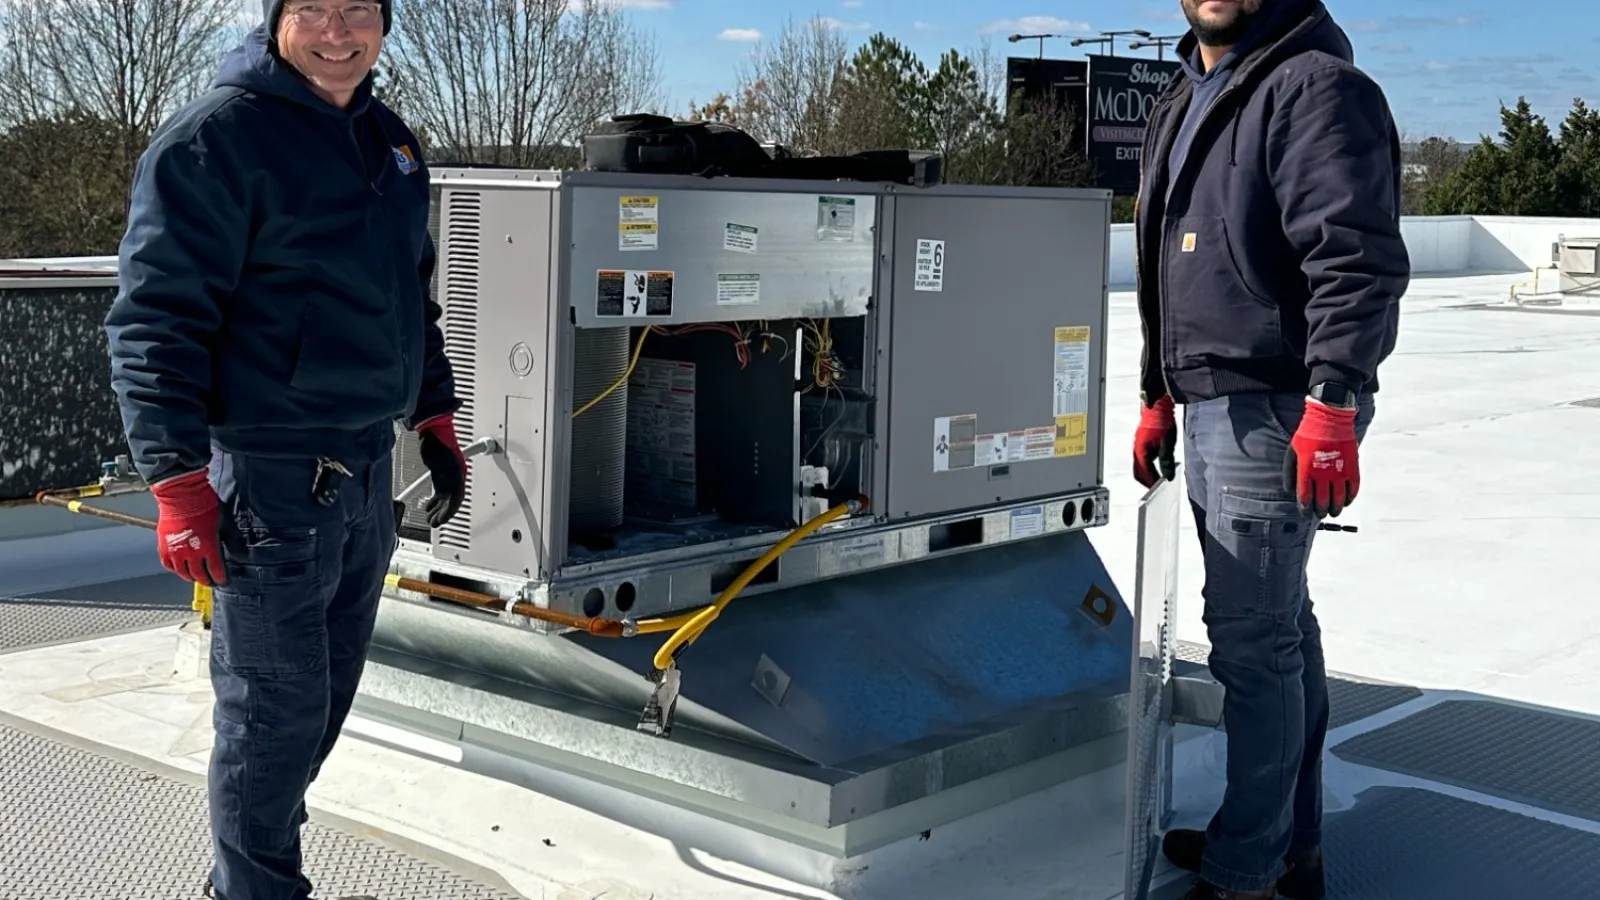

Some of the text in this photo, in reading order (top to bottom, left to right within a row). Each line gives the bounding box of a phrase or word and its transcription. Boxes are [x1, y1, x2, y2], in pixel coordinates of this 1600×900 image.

[1129, 62, 1170, 92] Shop
[1116, 146, 1141, 160] EXIT
[934, 243, 943, 267] 6
